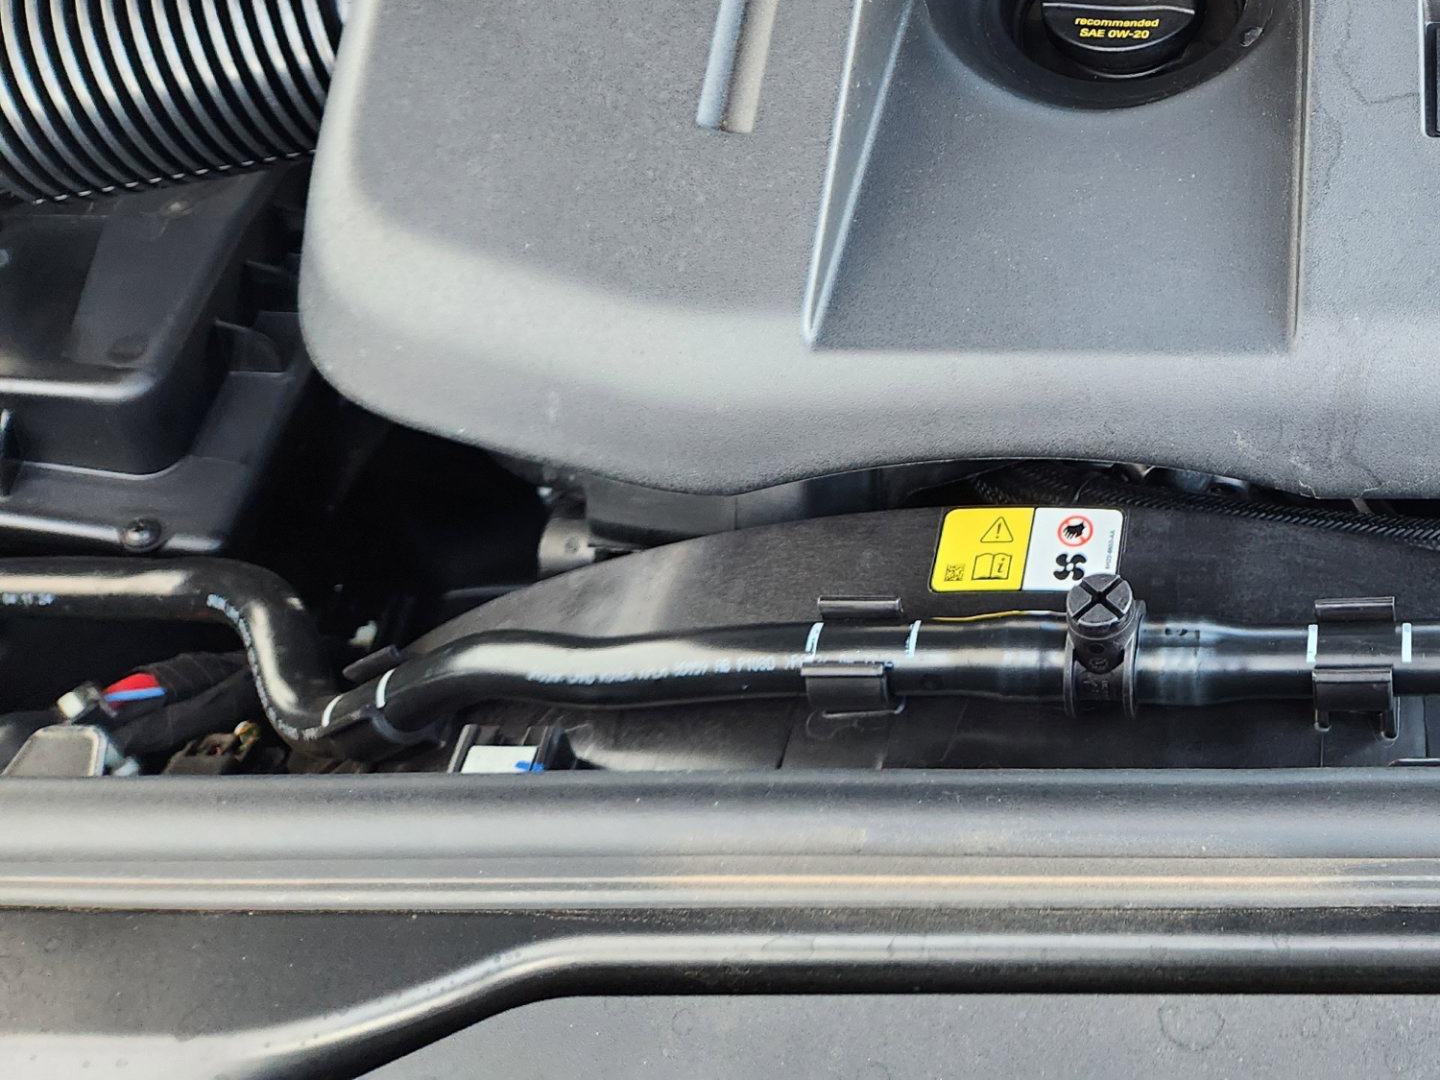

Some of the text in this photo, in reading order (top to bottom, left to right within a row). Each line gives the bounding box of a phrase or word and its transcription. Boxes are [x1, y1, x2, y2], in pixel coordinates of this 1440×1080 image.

[1075, 17, 1160, 28] recommended
[1079, 27, 1150, 39] SAE 0W-20
